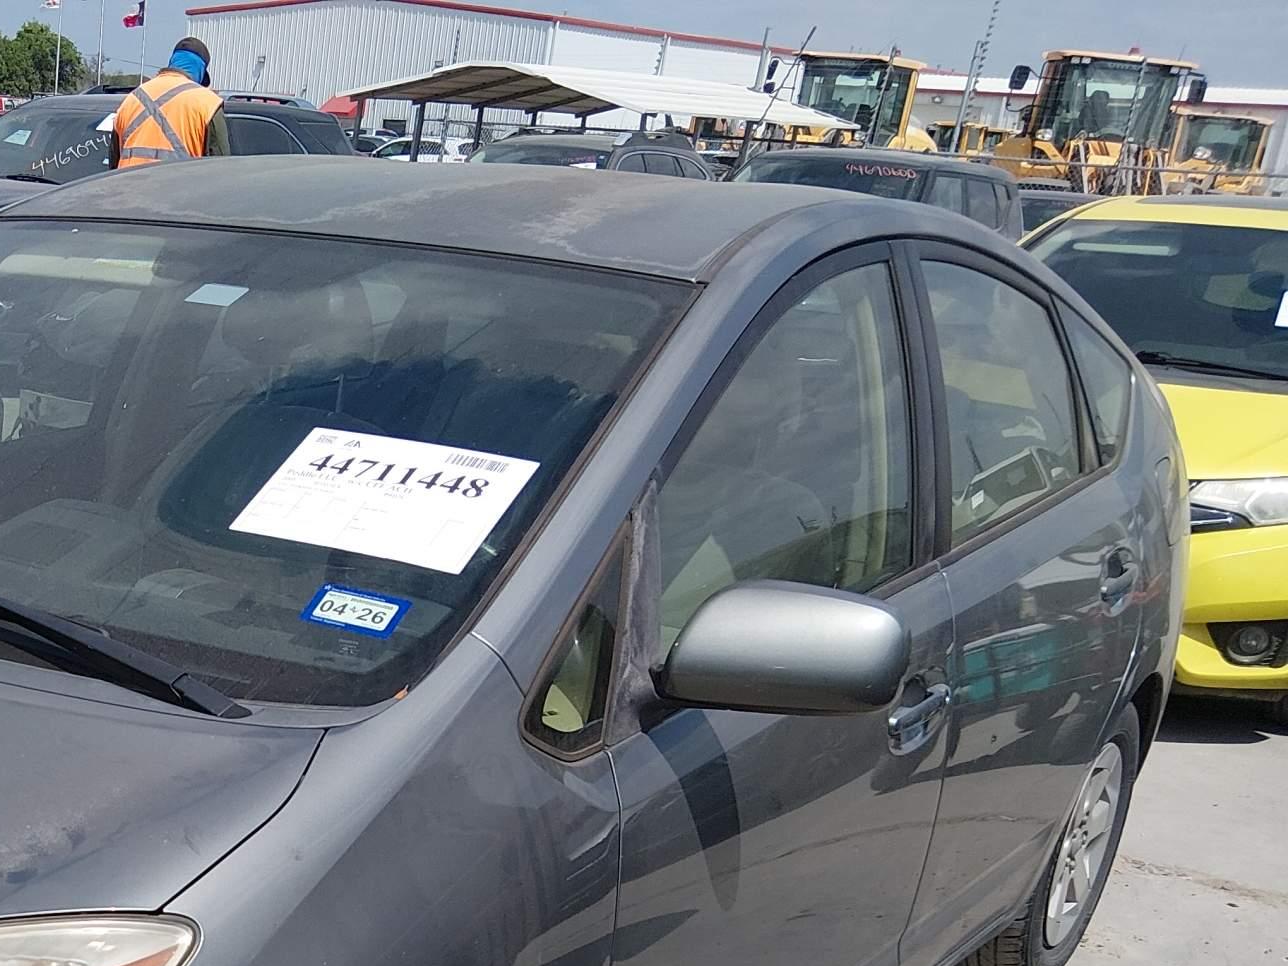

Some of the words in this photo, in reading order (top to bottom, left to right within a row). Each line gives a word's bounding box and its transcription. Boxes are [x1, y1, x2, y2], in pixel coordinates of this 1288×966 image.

[31, 133, 112, 176] 4469094
[308, 453, 490, 498] 44711448
[319, 599, 346, 616] 04
[356, 607, 387, 624] 26
